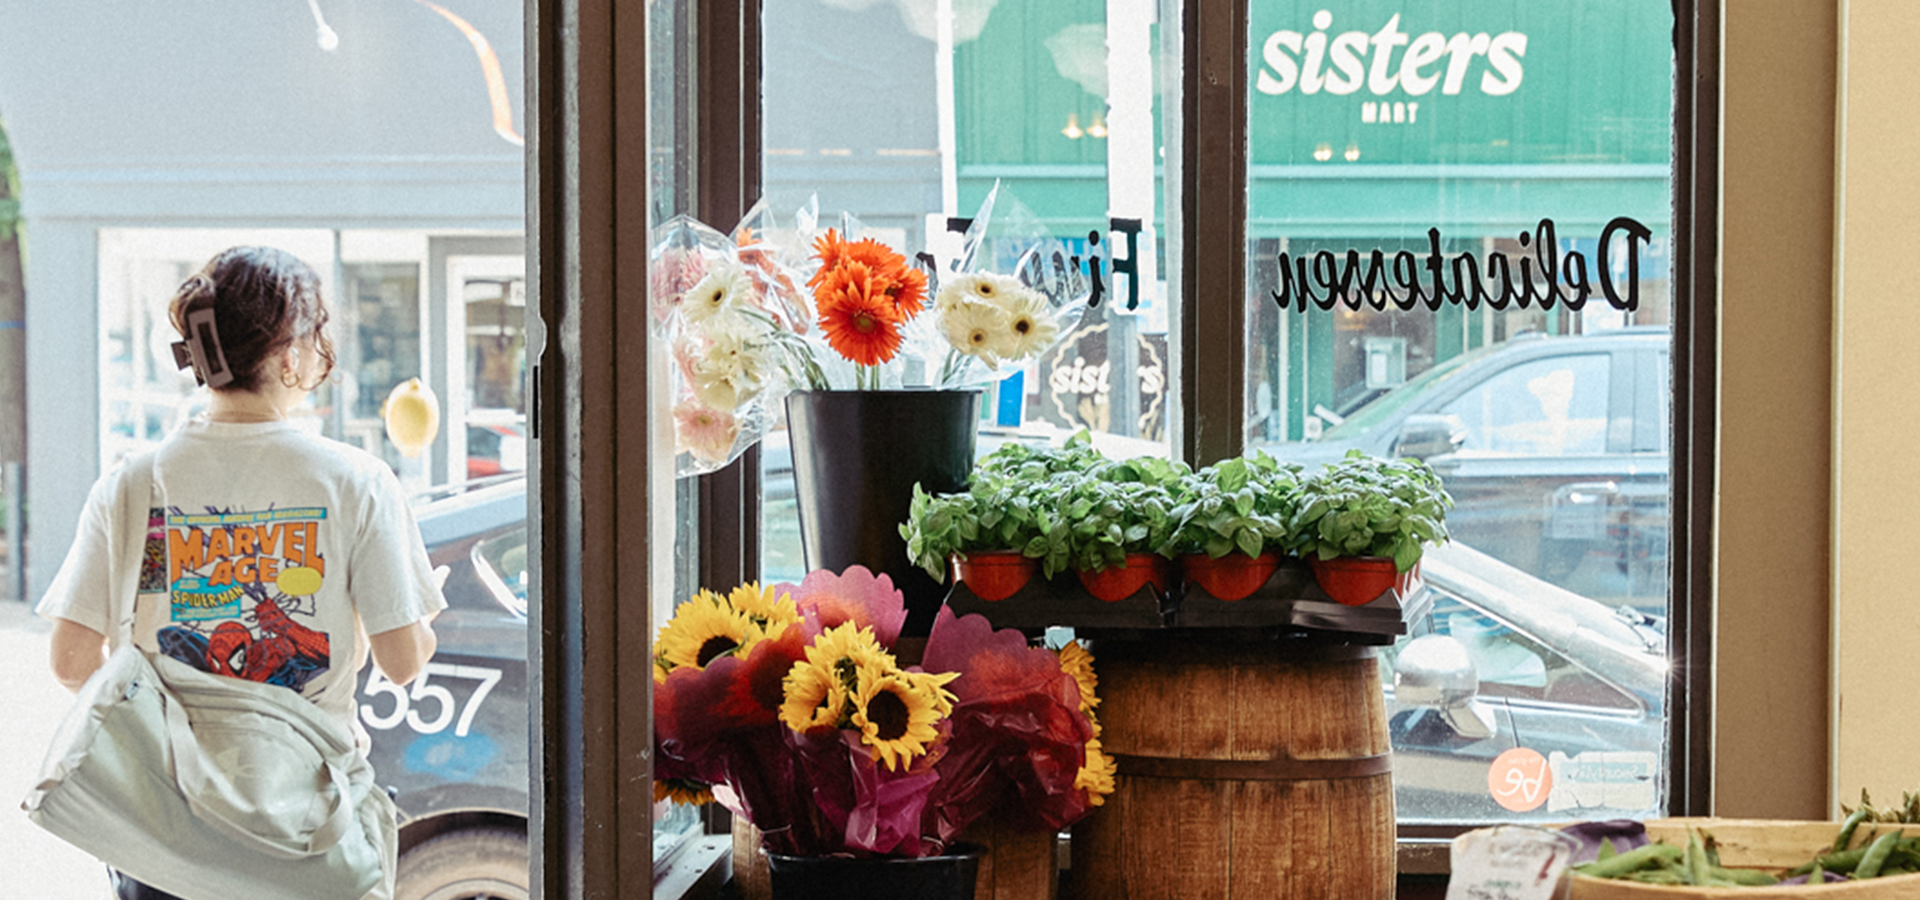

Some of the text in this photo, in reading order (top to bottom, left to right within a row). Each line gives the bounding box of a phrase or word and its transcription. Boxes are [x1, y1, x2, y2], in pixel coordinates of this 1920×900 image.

[1257, 10, 1528, 96] sisters
[1361, 101, 1419, 124] MART
[1052, 356, 1162, 394] sists
[168, 522, 325, 583] MARVEL
[208, 557, 278, 586] AGE
